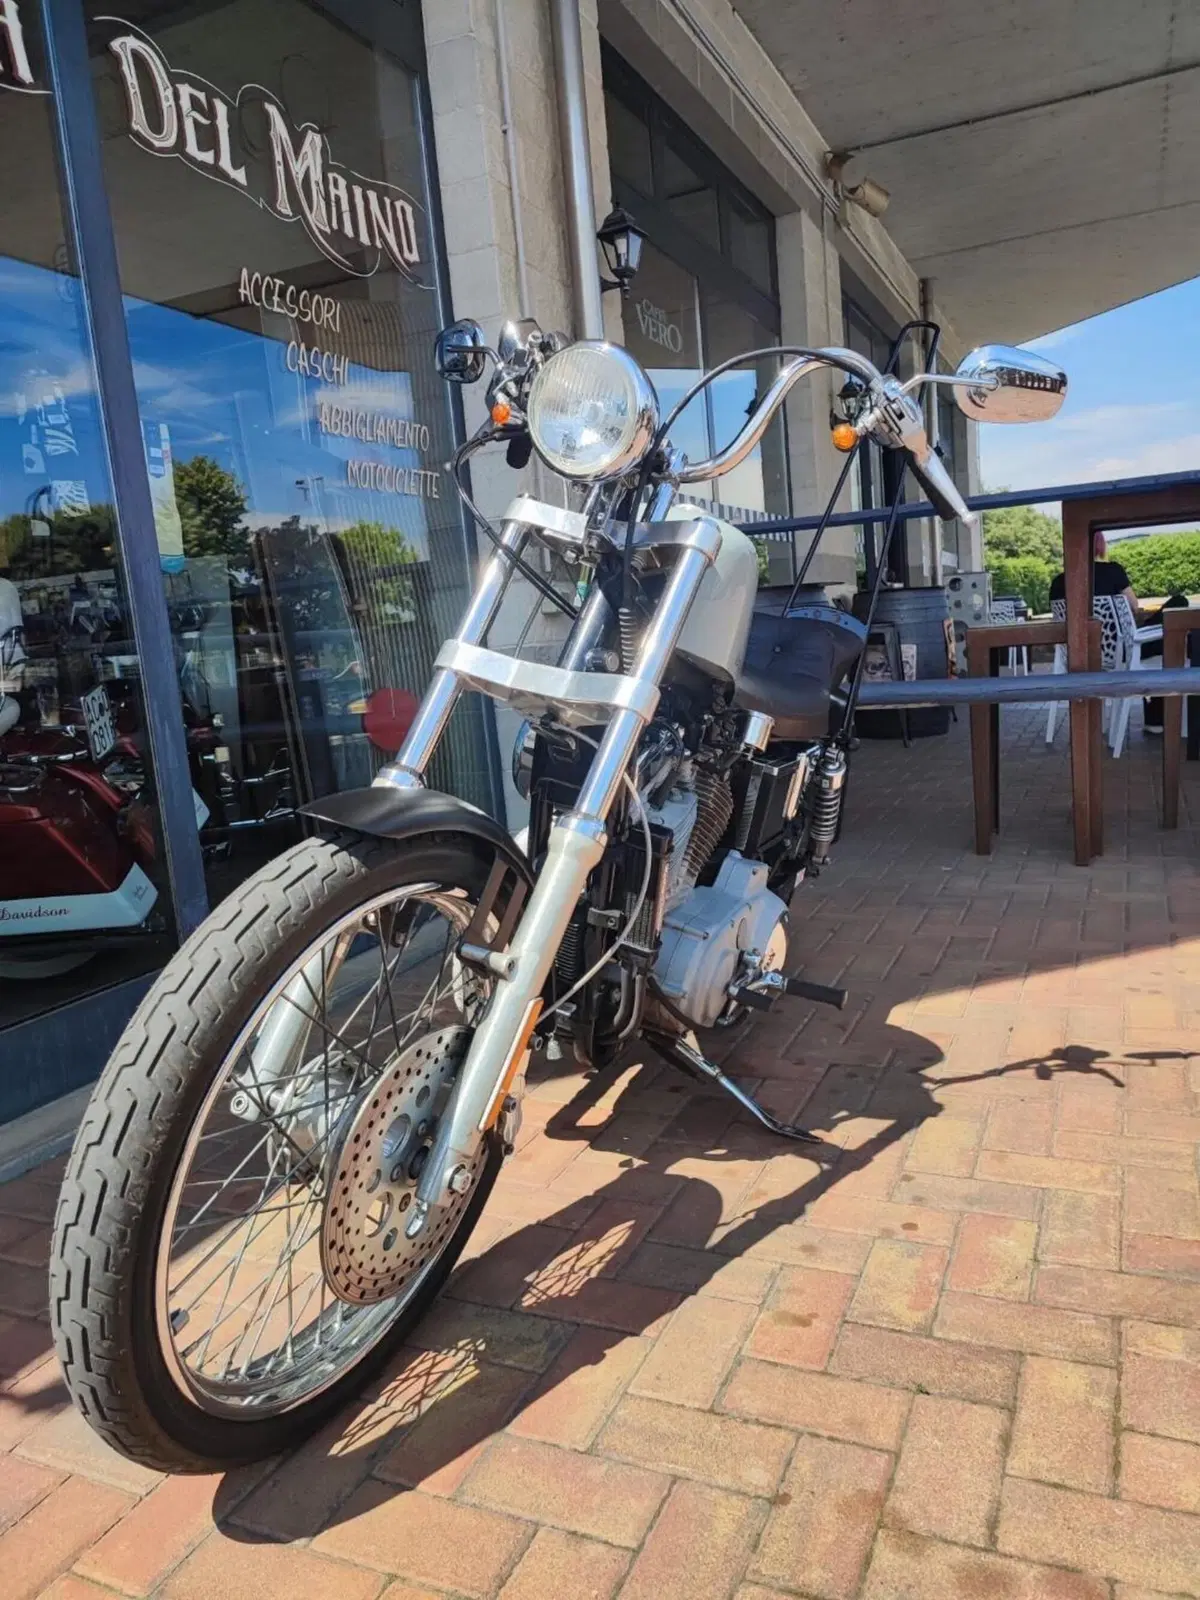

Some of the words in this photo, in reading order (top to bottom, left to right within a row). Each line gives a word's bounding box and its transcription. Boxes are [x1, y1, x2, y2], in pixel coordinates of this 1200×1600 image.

[238, 267, 341, 332] ACCESSORI
[635, 303, 683, 353] VERO
[286, 341, 349, 386] CASCHI
[319, 403, 430, 451] ABBIGLIAMENTO
[347, 460, 441, 498] MOTOCICLETTE
